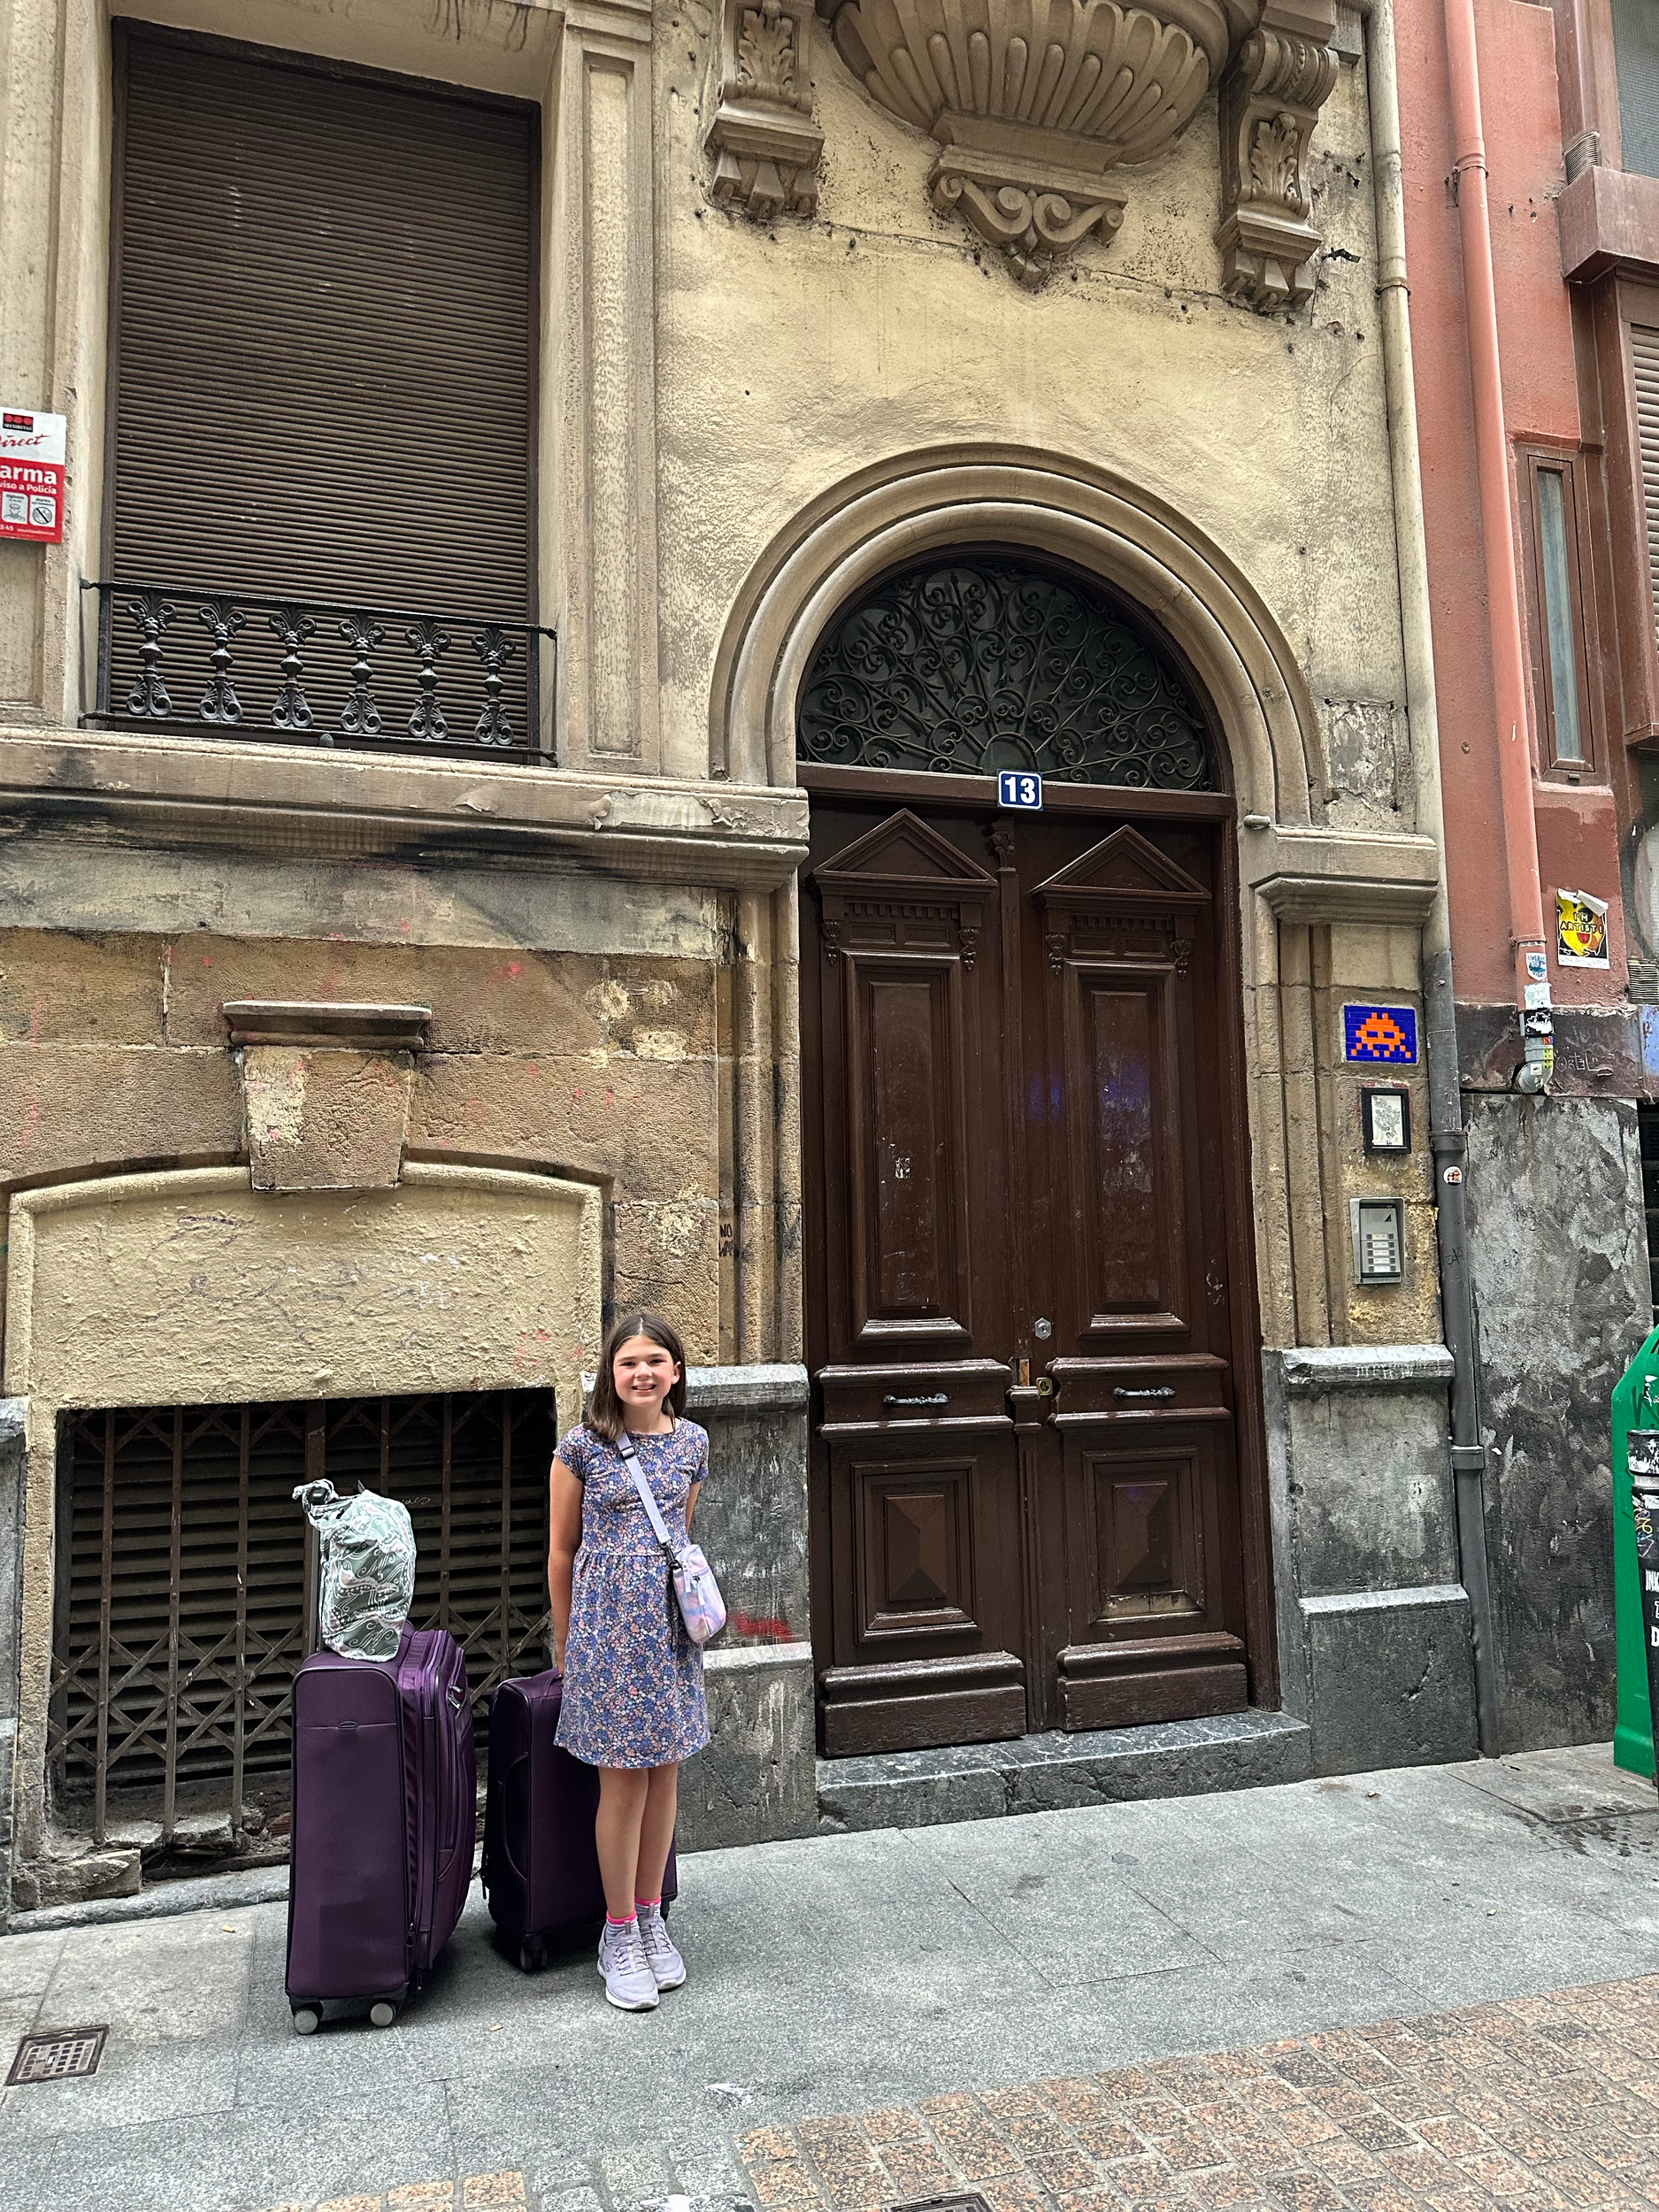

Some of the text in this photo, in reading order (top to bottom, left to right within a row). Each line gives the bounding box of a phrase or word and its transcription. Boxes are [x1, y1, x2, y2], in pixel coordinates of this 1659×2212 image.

[0, 434, 51, 448] irect
[1004, 776, 1036, 804] 13
[1573, 911, 1588, 922] I'M
[719, 1223, 733, 1238] NO
